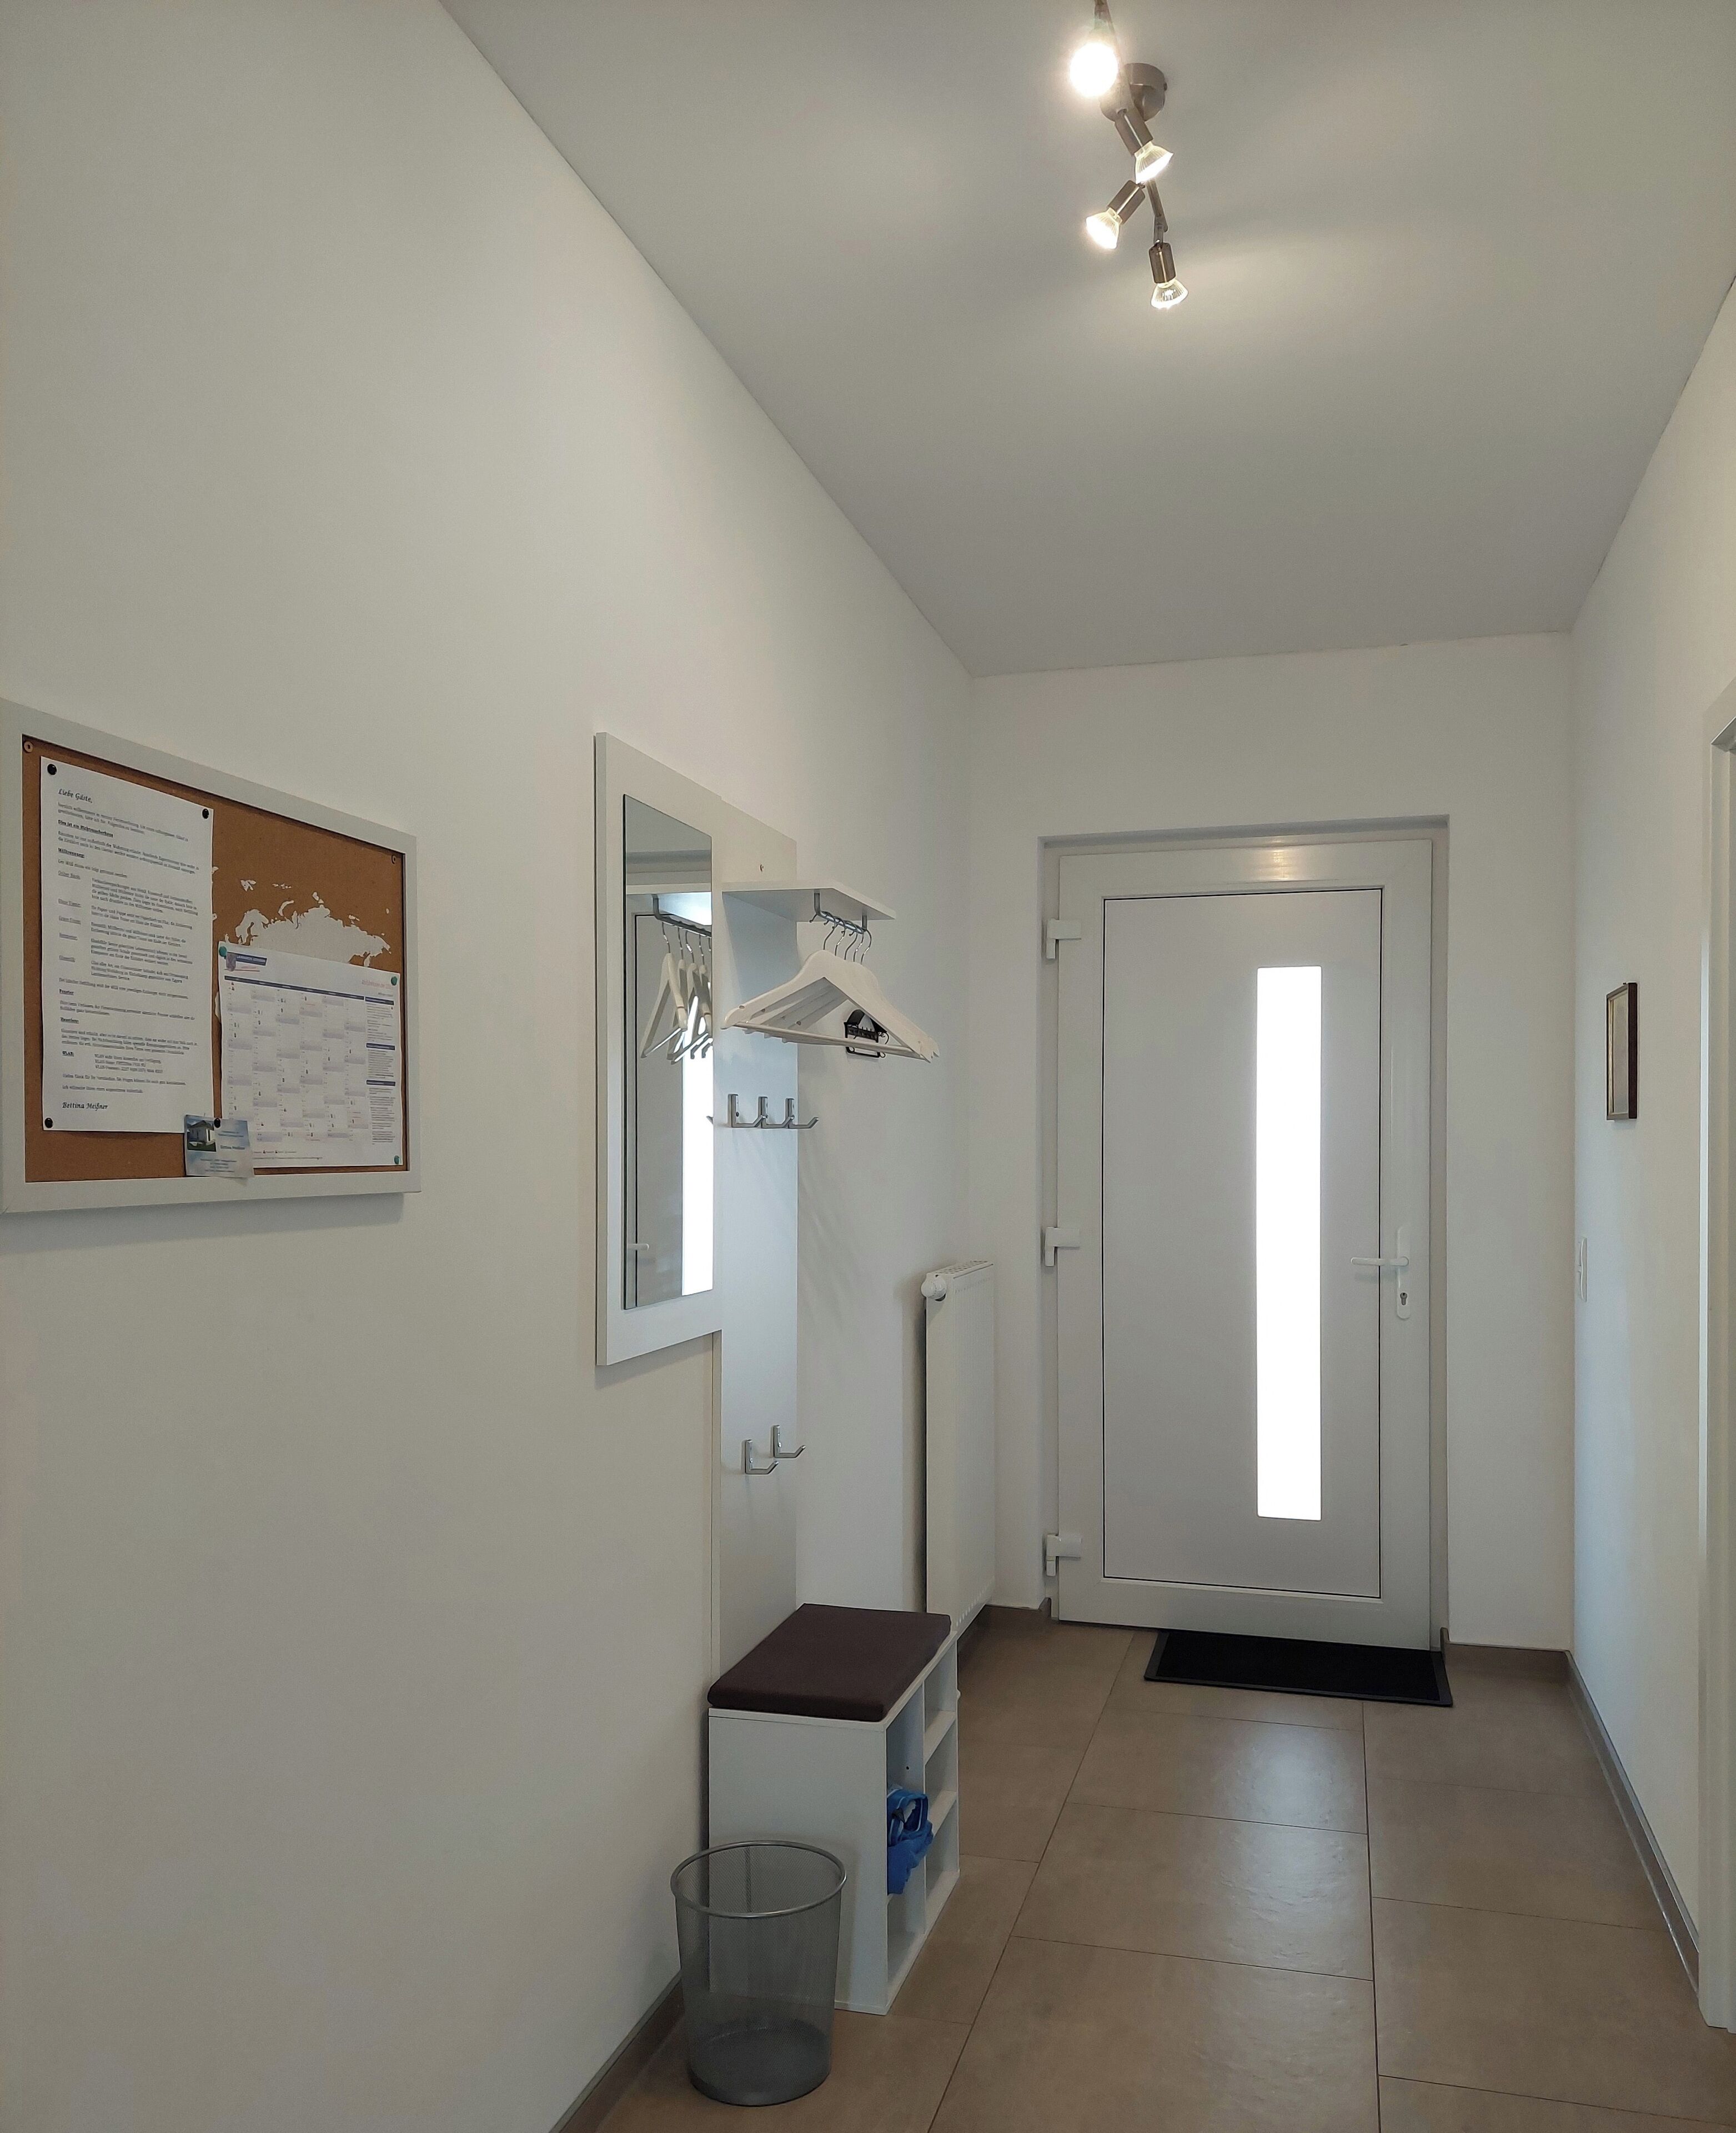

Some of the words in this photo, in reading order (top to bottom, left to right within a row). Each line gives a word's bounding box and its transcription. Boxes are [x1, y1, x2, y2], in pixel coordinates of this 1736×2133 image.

[58, 788, 73, 798] Liebe
[75, 793, 92, 804] Gäste,
[86, 1103, 108, 1111] Meißner
